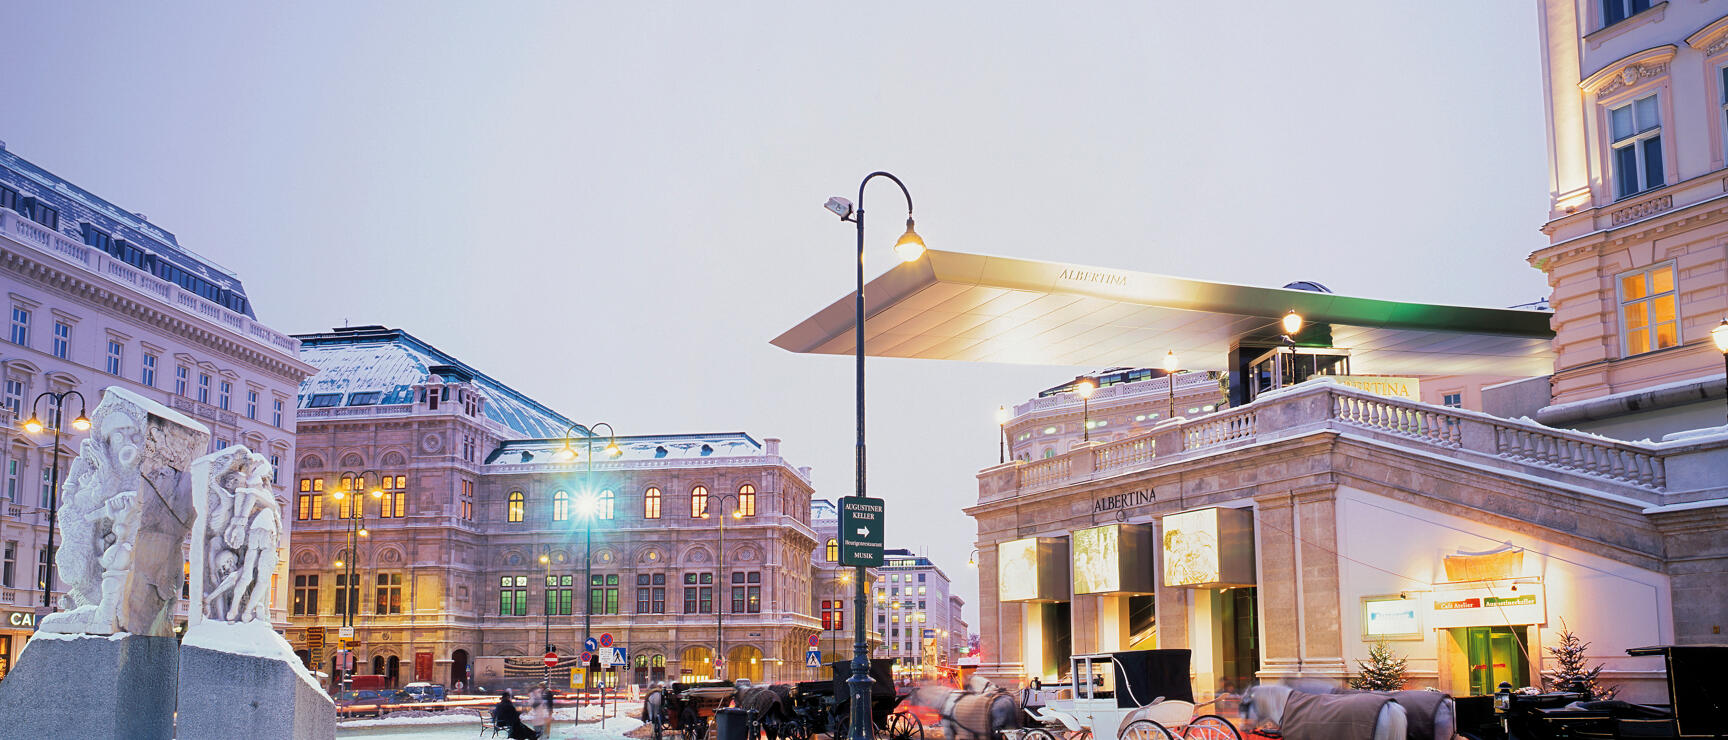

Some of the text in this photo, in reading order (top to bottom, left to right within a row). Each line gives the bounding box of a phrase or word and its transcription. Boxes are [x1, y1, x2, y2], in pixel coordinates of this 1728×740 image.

[1058, 268, 1128, 286] ALBERTINA
[1093, 488, 1157, 513] ALBERTINA
[845, 503, 883, 512] AUGUSTINER
[852, 512, 875, 520] KELLER
